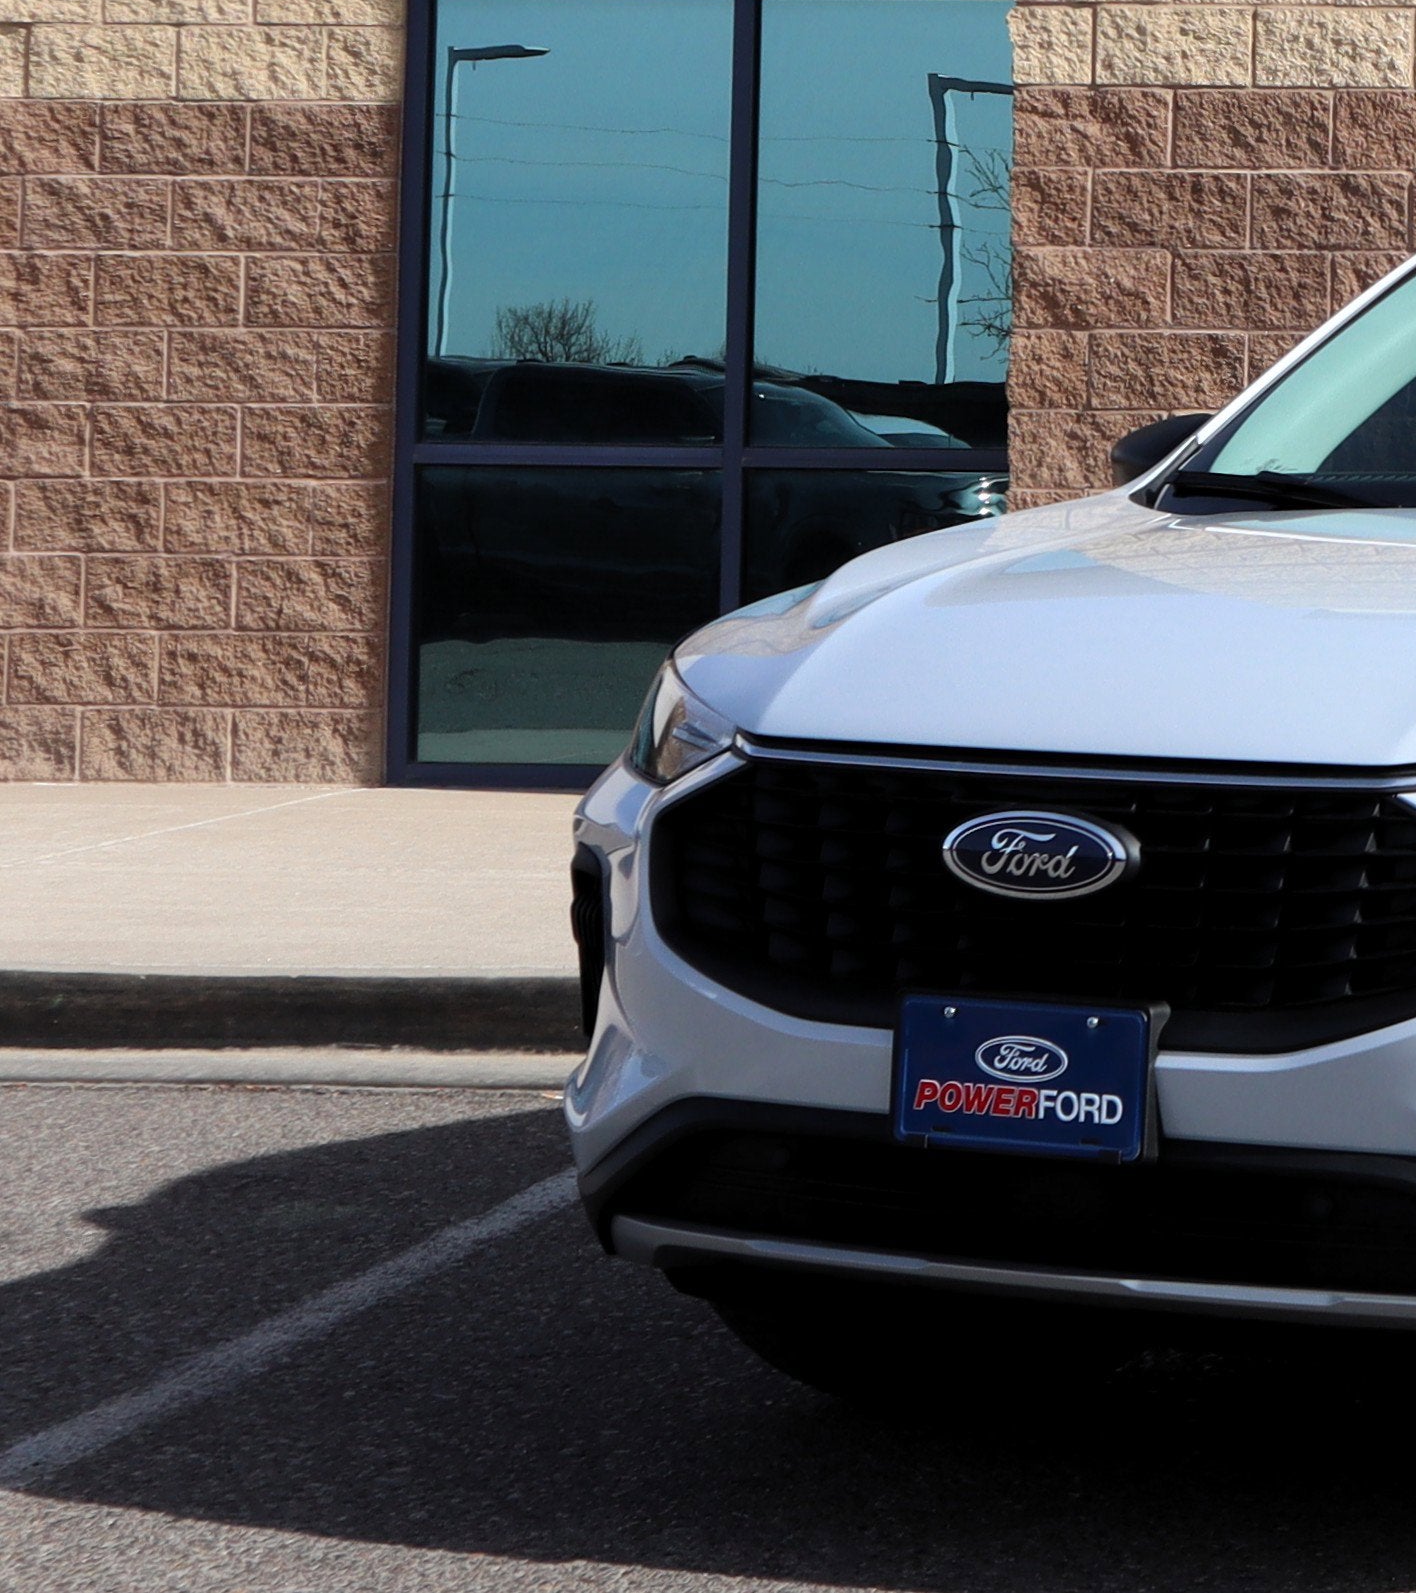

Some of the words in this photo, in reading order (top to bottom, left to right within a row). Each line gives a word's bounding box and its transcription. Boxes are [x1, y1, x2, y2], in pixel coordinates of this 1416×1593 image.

[981, 828, 1078, 878] Ford
[994, 1042, 1048, 1074] Ford
[914, 1078, 1123, 1125] POWERFORD
